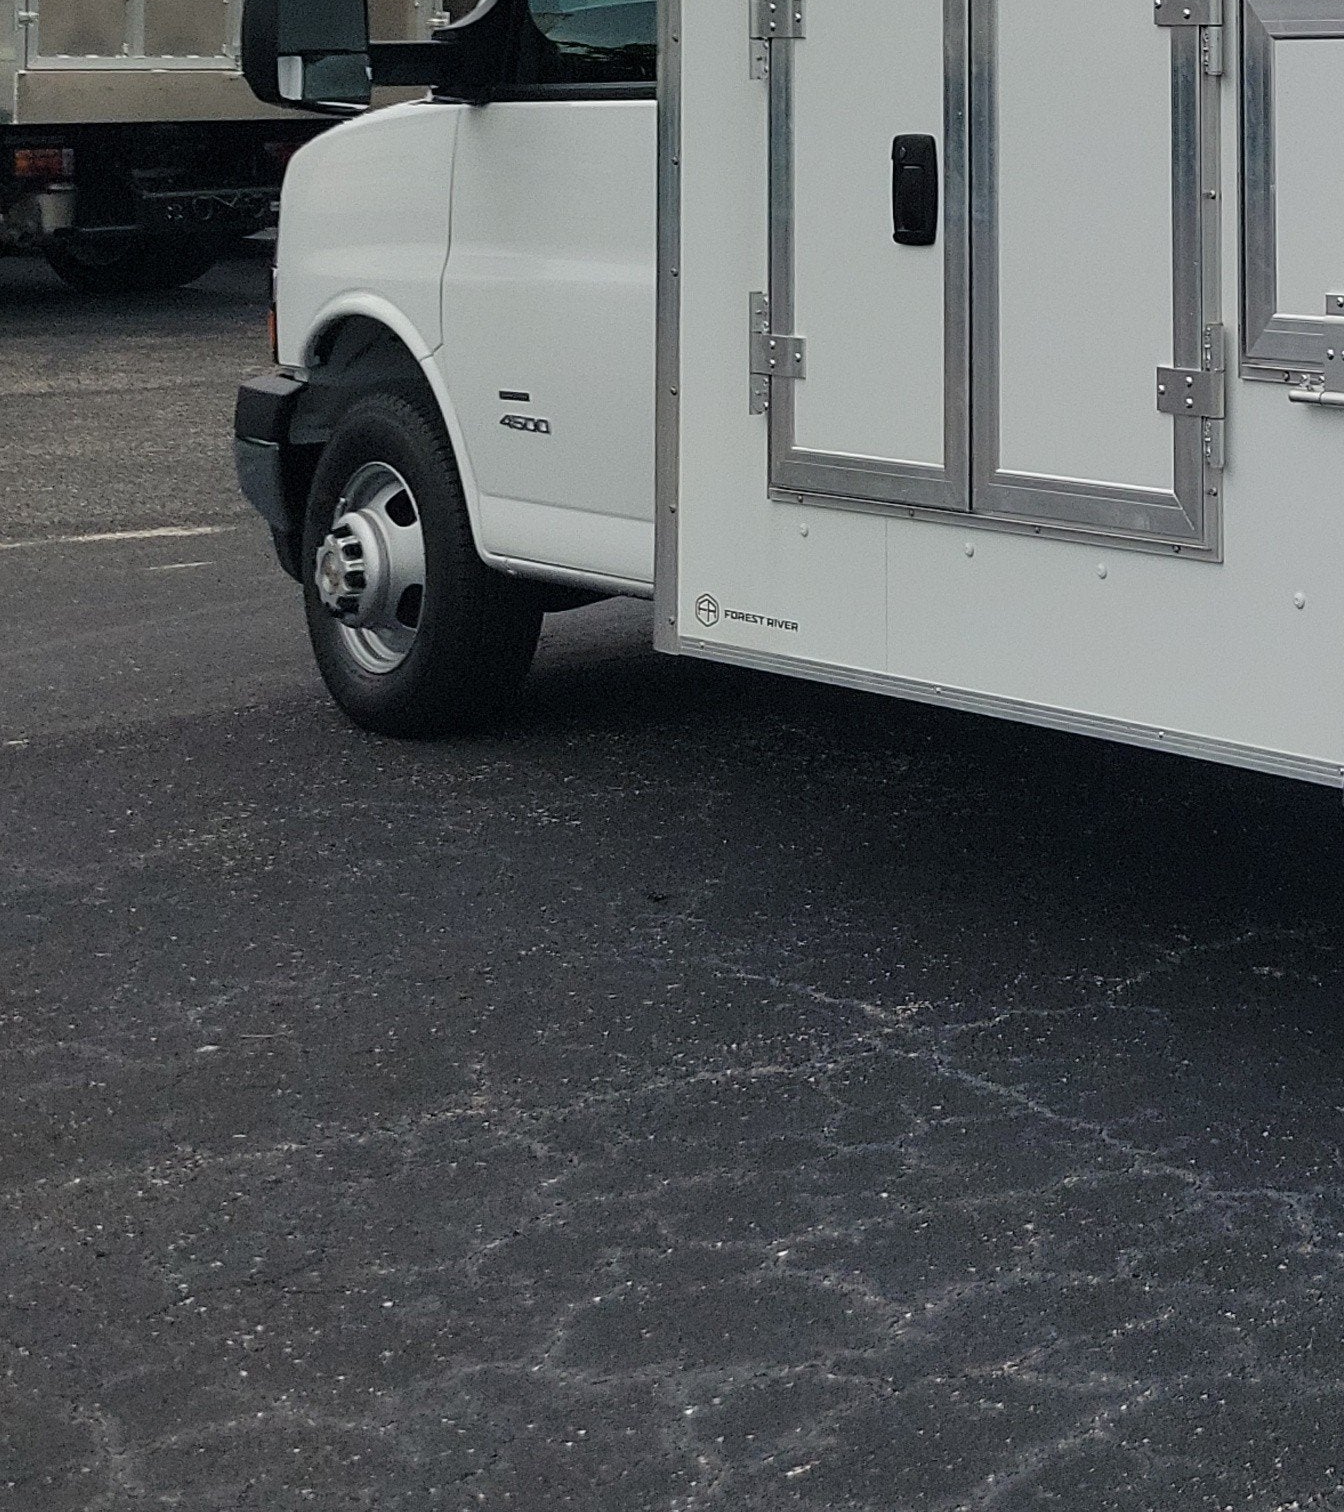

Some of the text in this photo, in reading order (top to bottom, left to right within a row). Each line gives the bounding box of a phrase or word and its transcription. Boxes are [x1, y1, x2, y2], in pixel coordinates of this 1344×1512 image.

[499, 414, 551, 435] 4500
[724, 609, 765, 626] FOREST
[766, 617, 799, 632] RIVER
